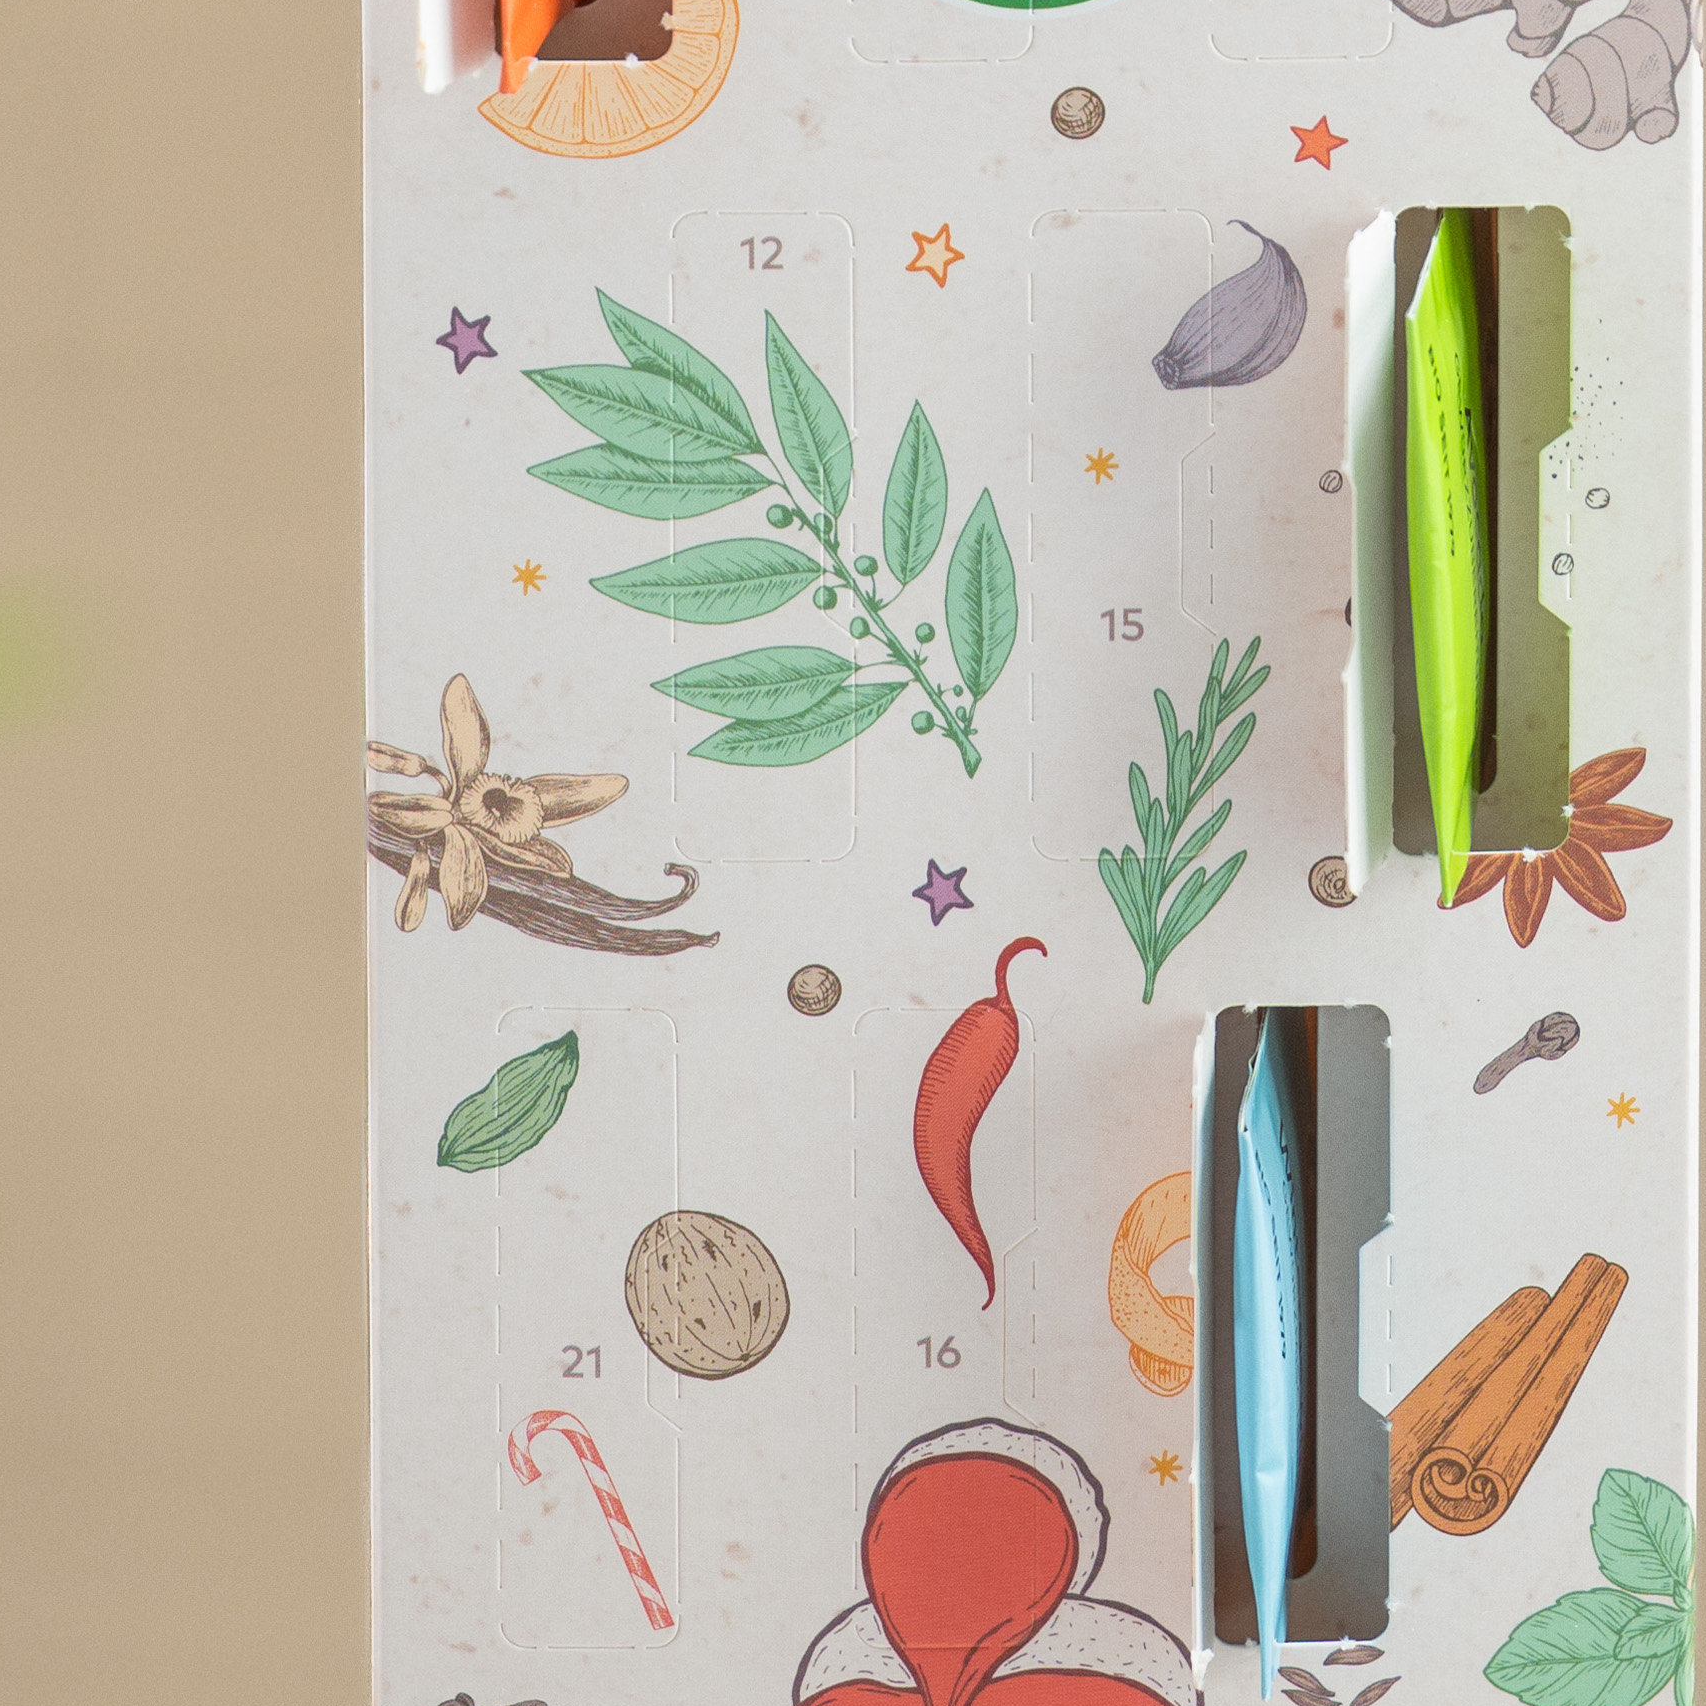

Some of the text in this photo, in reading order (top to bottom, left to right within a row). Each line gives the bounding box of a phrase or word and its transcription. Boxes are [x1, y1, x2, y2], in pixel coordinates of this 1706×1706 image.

[740, 236, 783, 270] 12
[1101, 608, 1145, 642] 15
[562, 1344, 602, 1379] 21
[917, 1335, 962, 1369] 16
